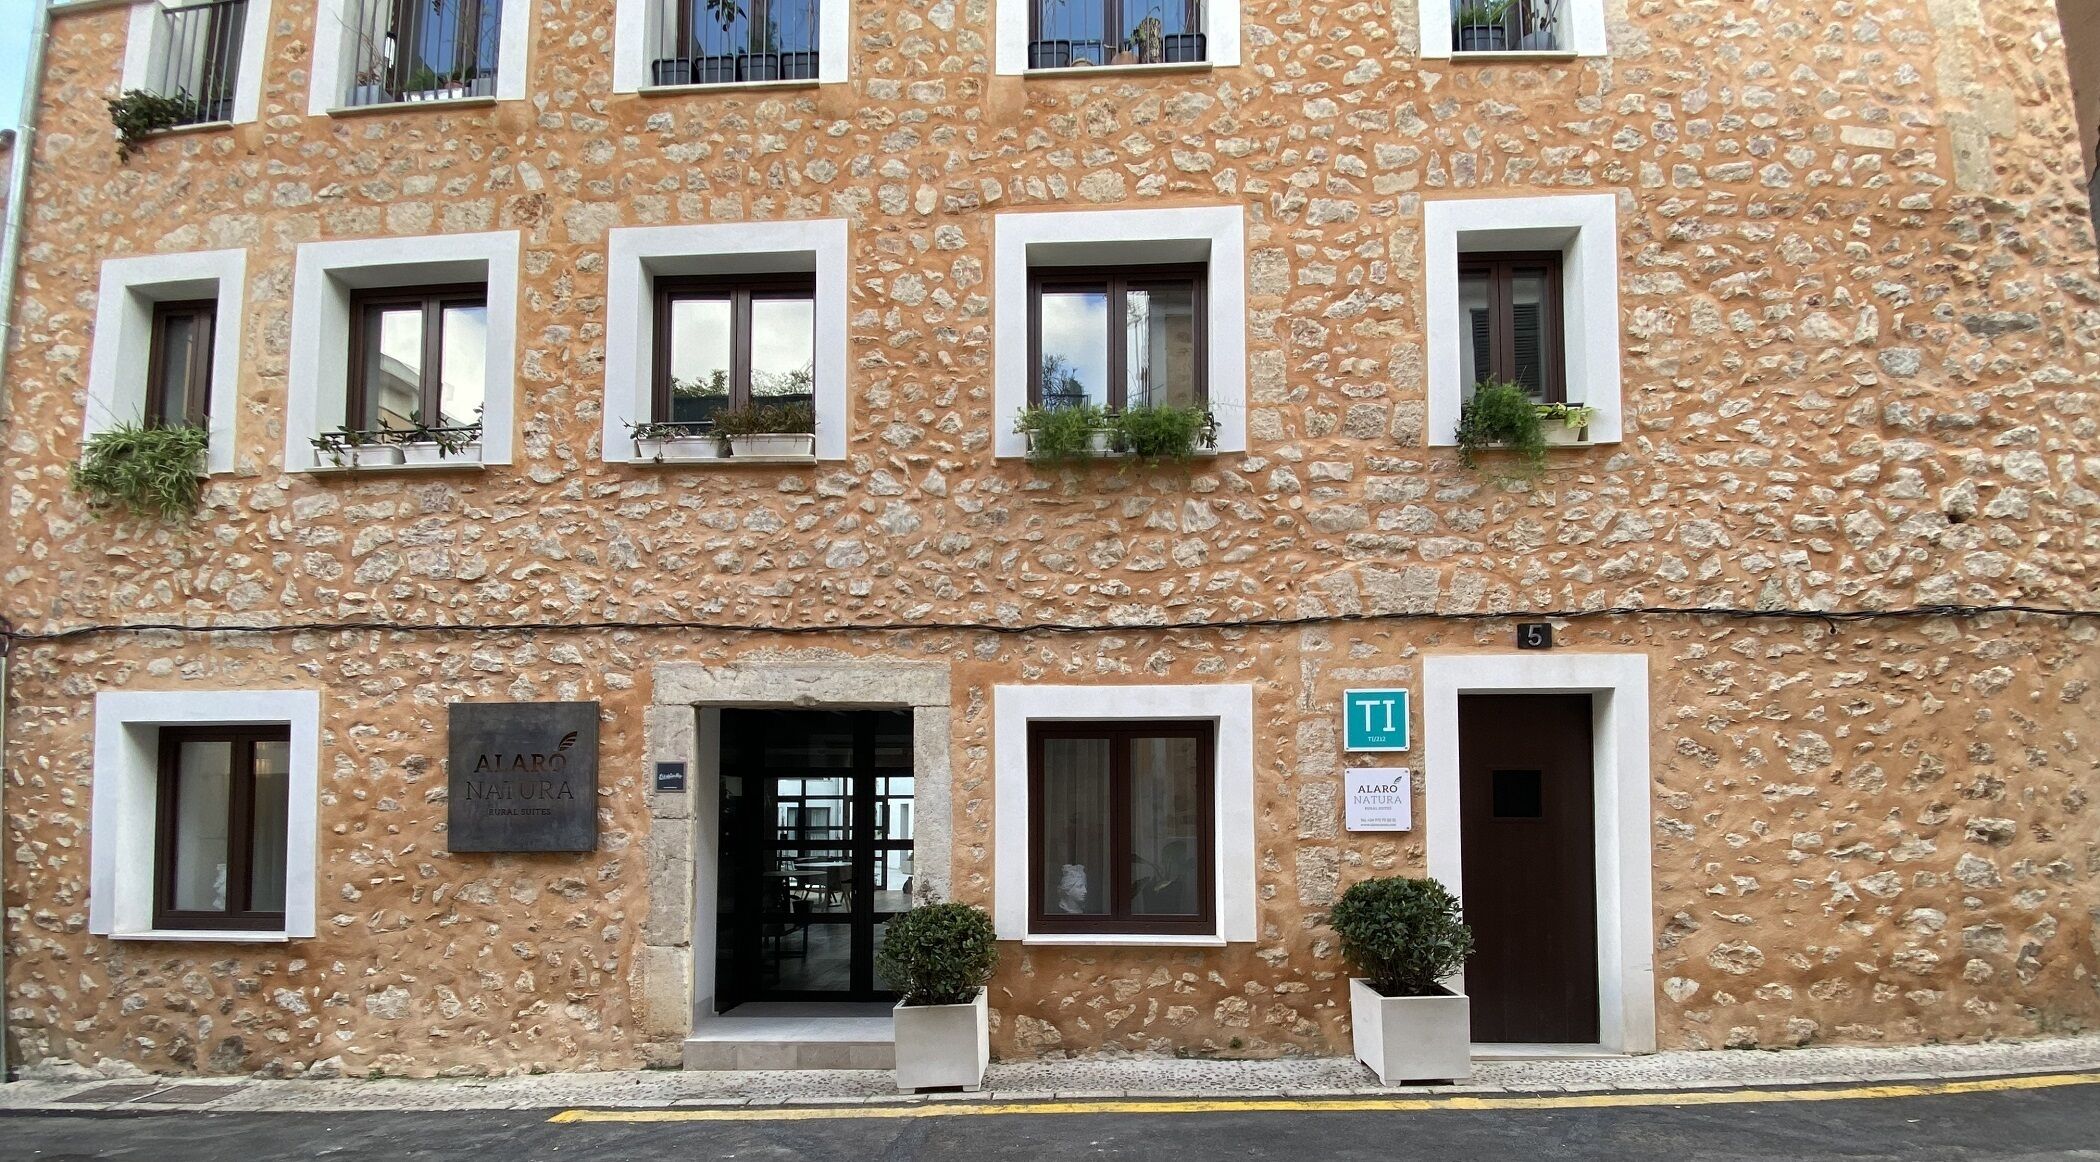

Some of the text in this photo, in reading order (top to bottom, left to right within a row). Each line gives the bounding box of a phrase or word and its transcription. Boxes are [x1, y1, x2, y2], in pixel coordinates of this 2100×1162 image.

[1528, 624, 1543, 646] 5
[1355, 700, 1396, 732] TI
[466, 781, 574, 800] NATURA
[1353, 795, 1402, 804] NATURA
[488, 808, 551, 816] RURAL SUITES
